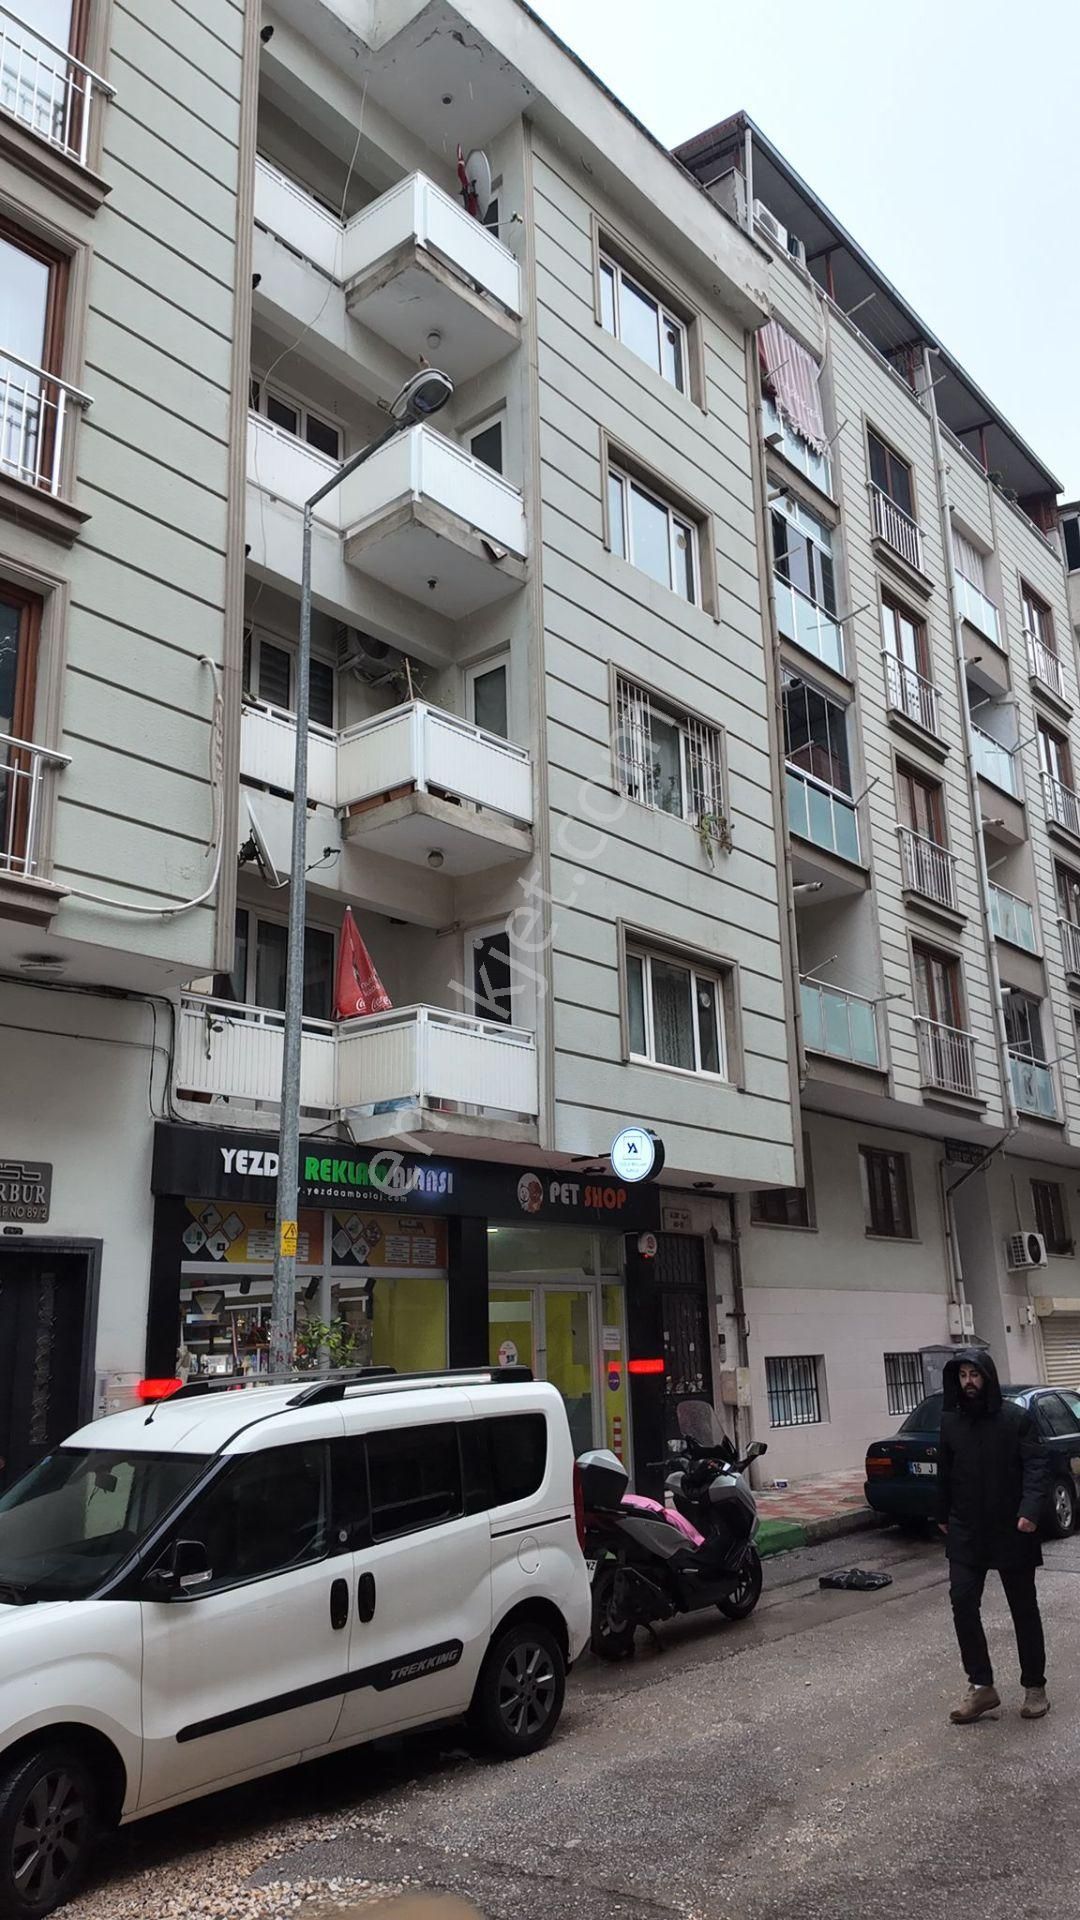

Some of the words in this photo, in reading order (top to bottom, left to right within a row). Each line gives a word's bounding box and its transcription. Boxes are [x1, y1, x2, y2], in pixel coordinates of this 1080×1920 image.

[220, 1147, 280, 1178] YEZD
[549, 1181, 580, 1206] PET
[584, 1184, 628, 1210] SHOP
[10, 1206, 25, 1218] NO
[390, 1649, 459, 1681] TREKKING
